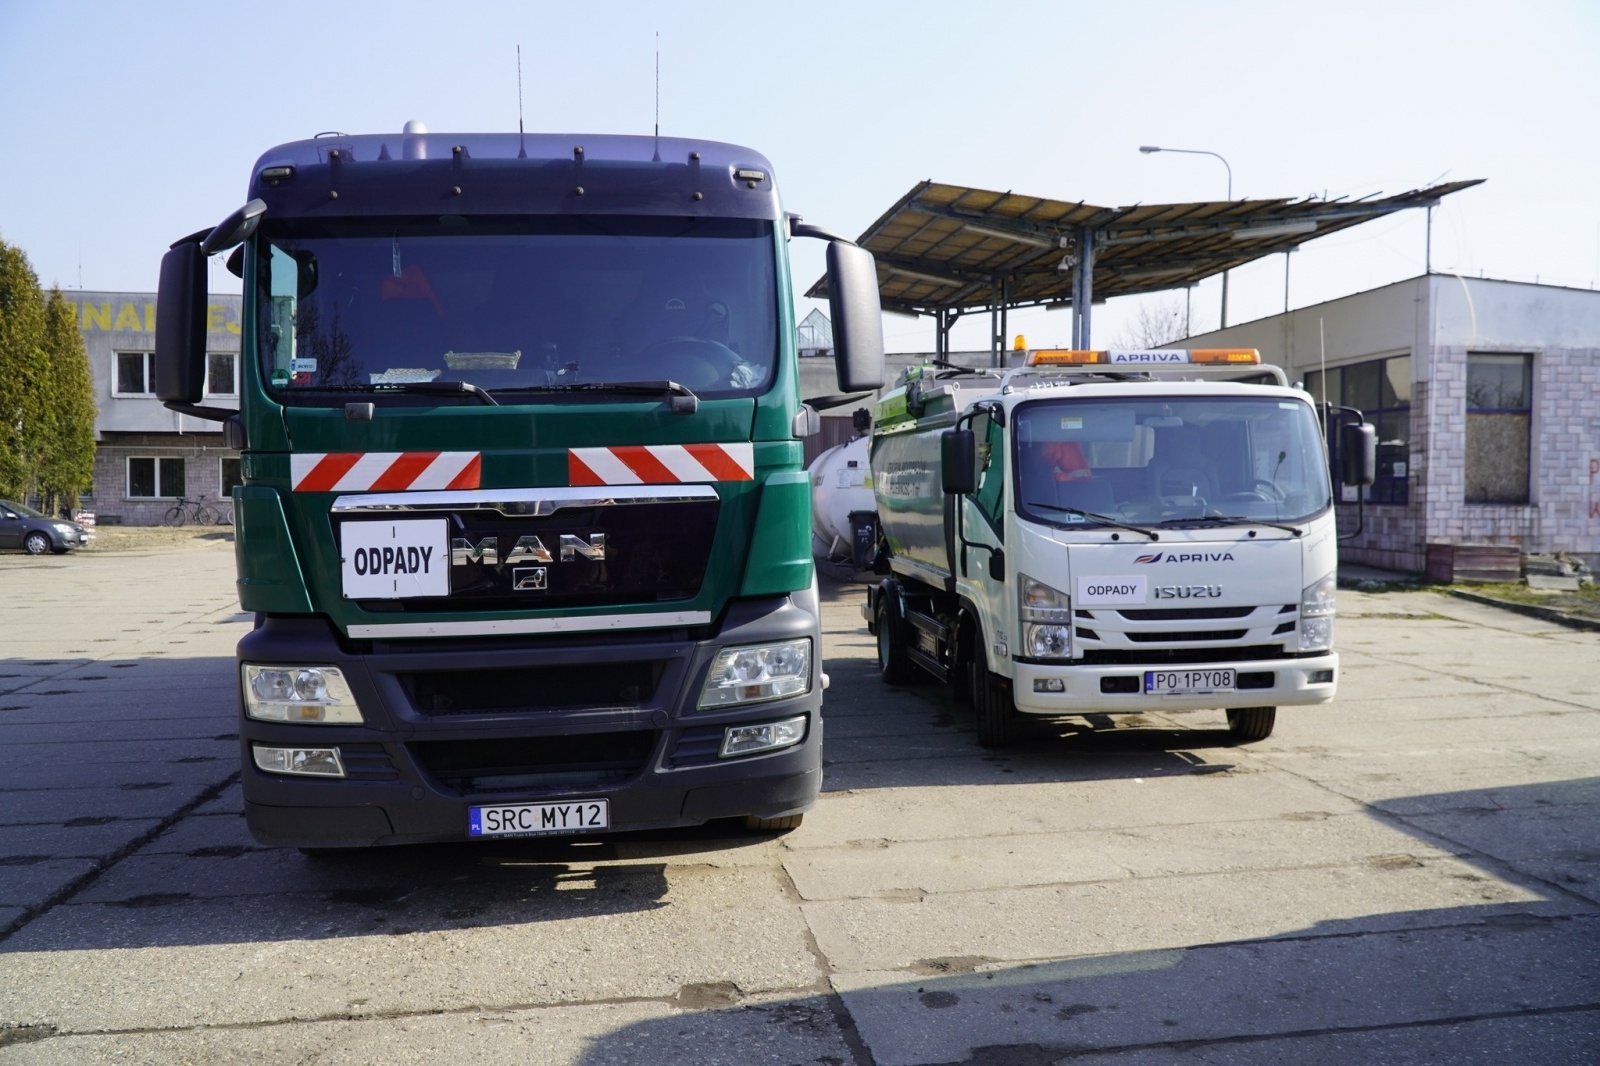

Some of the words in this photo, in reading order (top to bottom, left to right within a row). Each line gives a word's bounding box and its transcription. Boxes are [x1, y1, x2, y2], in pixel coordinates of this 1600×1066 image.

[1116, 353, 1180, 362] APRIVA
[452, 533, 605, 566] MAN
[354, 546, 434, 576] ODPADY
[1165, 553, 1235, 563] APRIVA
[1087, 585, 1137, 596] ODPADY
[1154, 585, 1223, 599] ISUZU
[1156, 673, 1177, 689] PO
[1184, 671, 1231, 688] 1PY08
[486, 808, 532, 831] SRC
[541, 804, 601, 828] MY12
